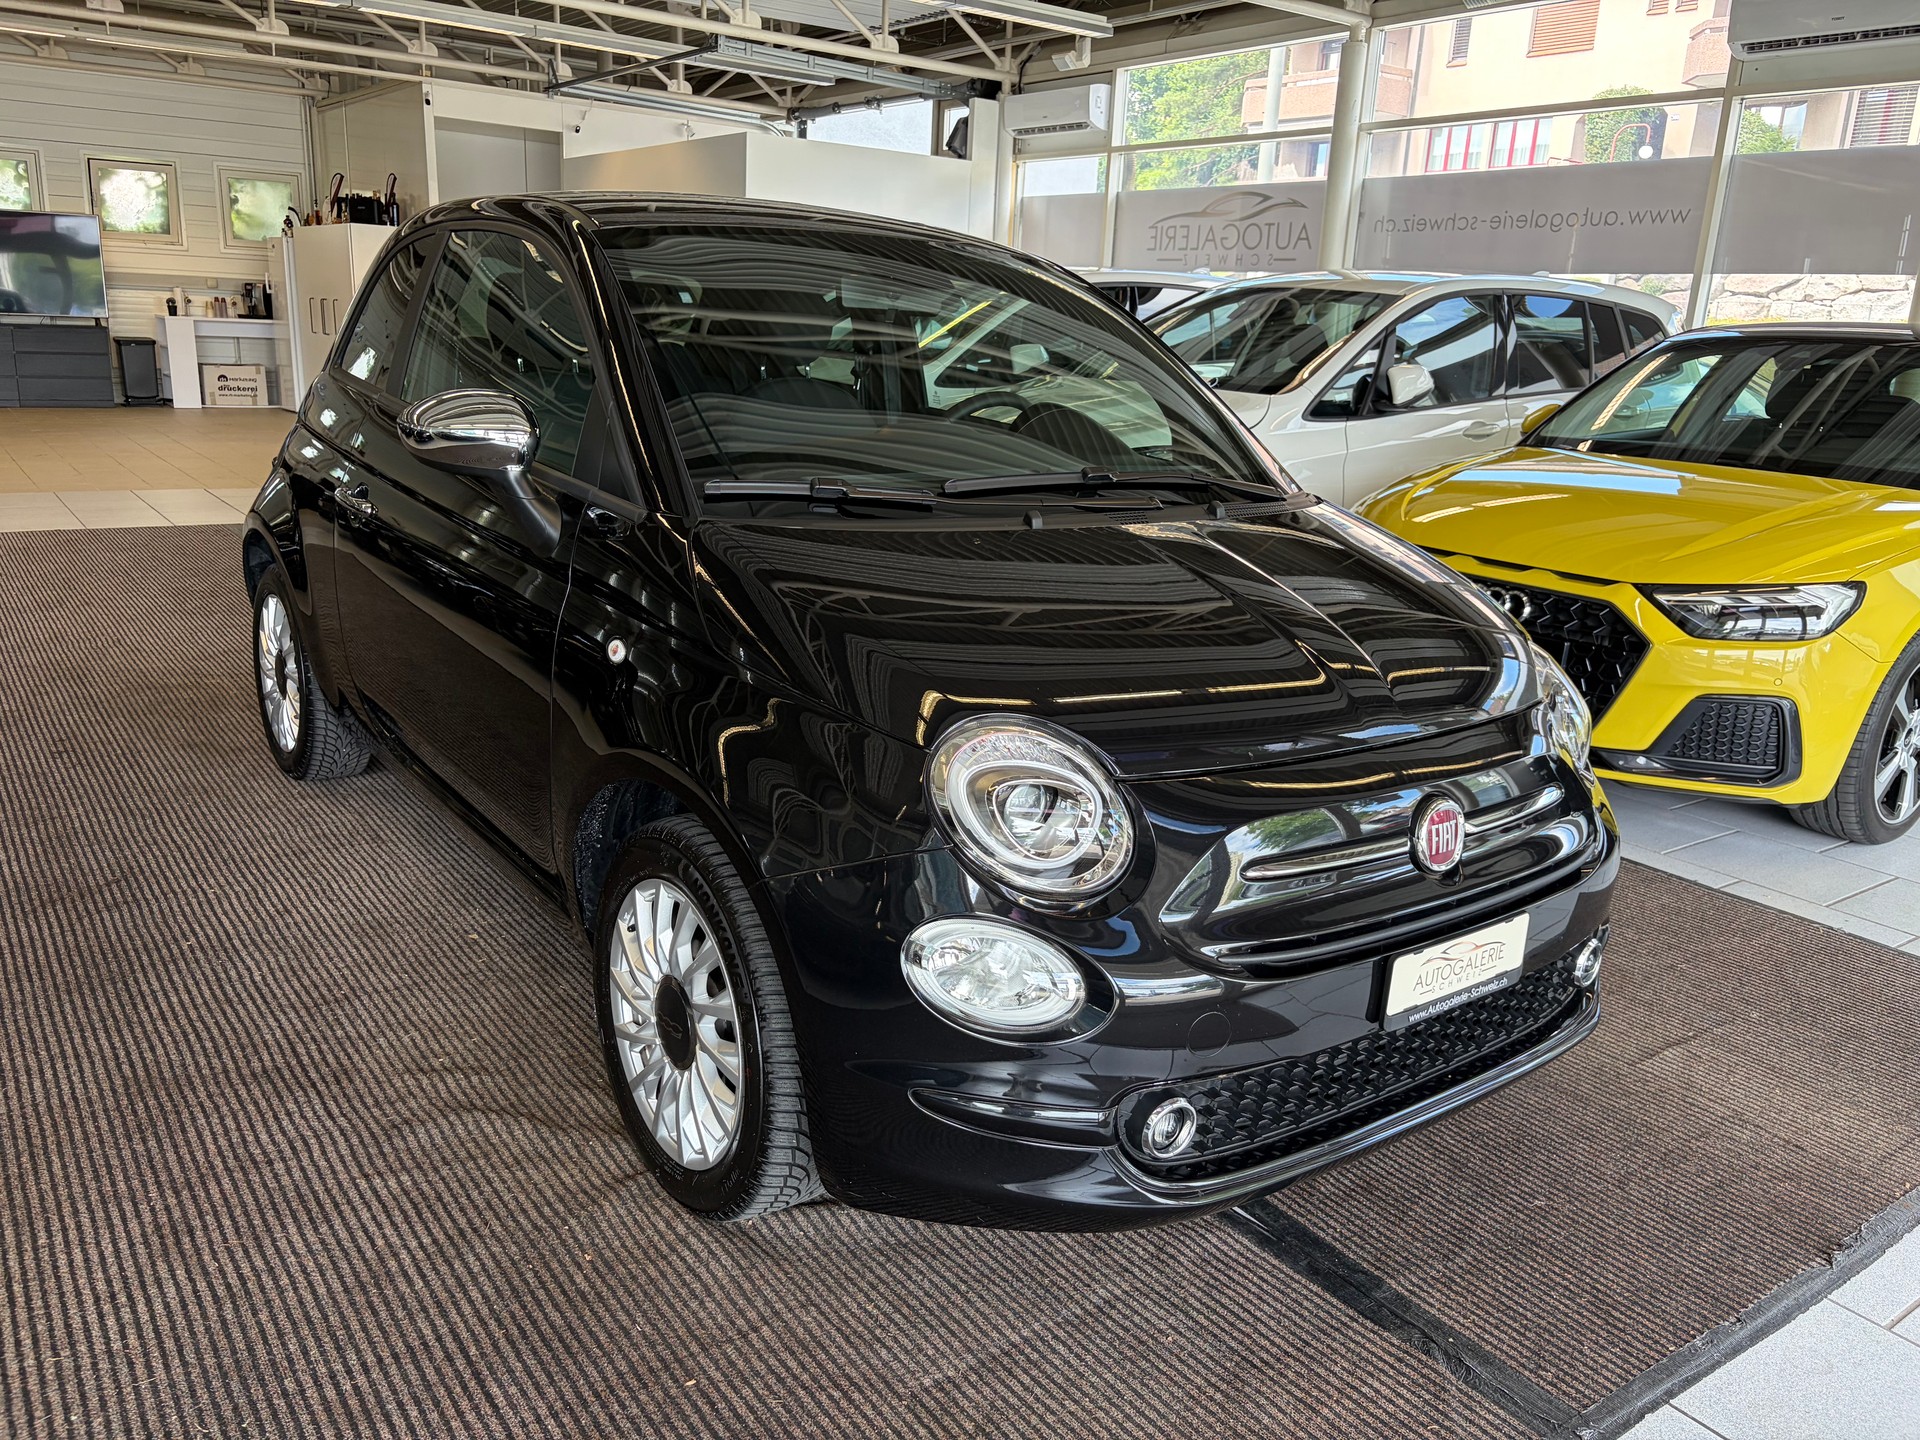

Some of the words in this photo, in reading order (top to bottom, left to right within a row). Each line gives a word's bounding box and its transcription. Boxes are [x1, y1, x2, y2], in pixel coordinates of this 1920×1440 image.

[1431, 820, 1456, 855] FIAT
[1412, 945, 1505, 992] AUTOGALERIE
[1431, 968, 1483, 994] SCHWEIZ
[1408, 977, 1508, 1023] www.Autogalerie-Schweiz.ch
